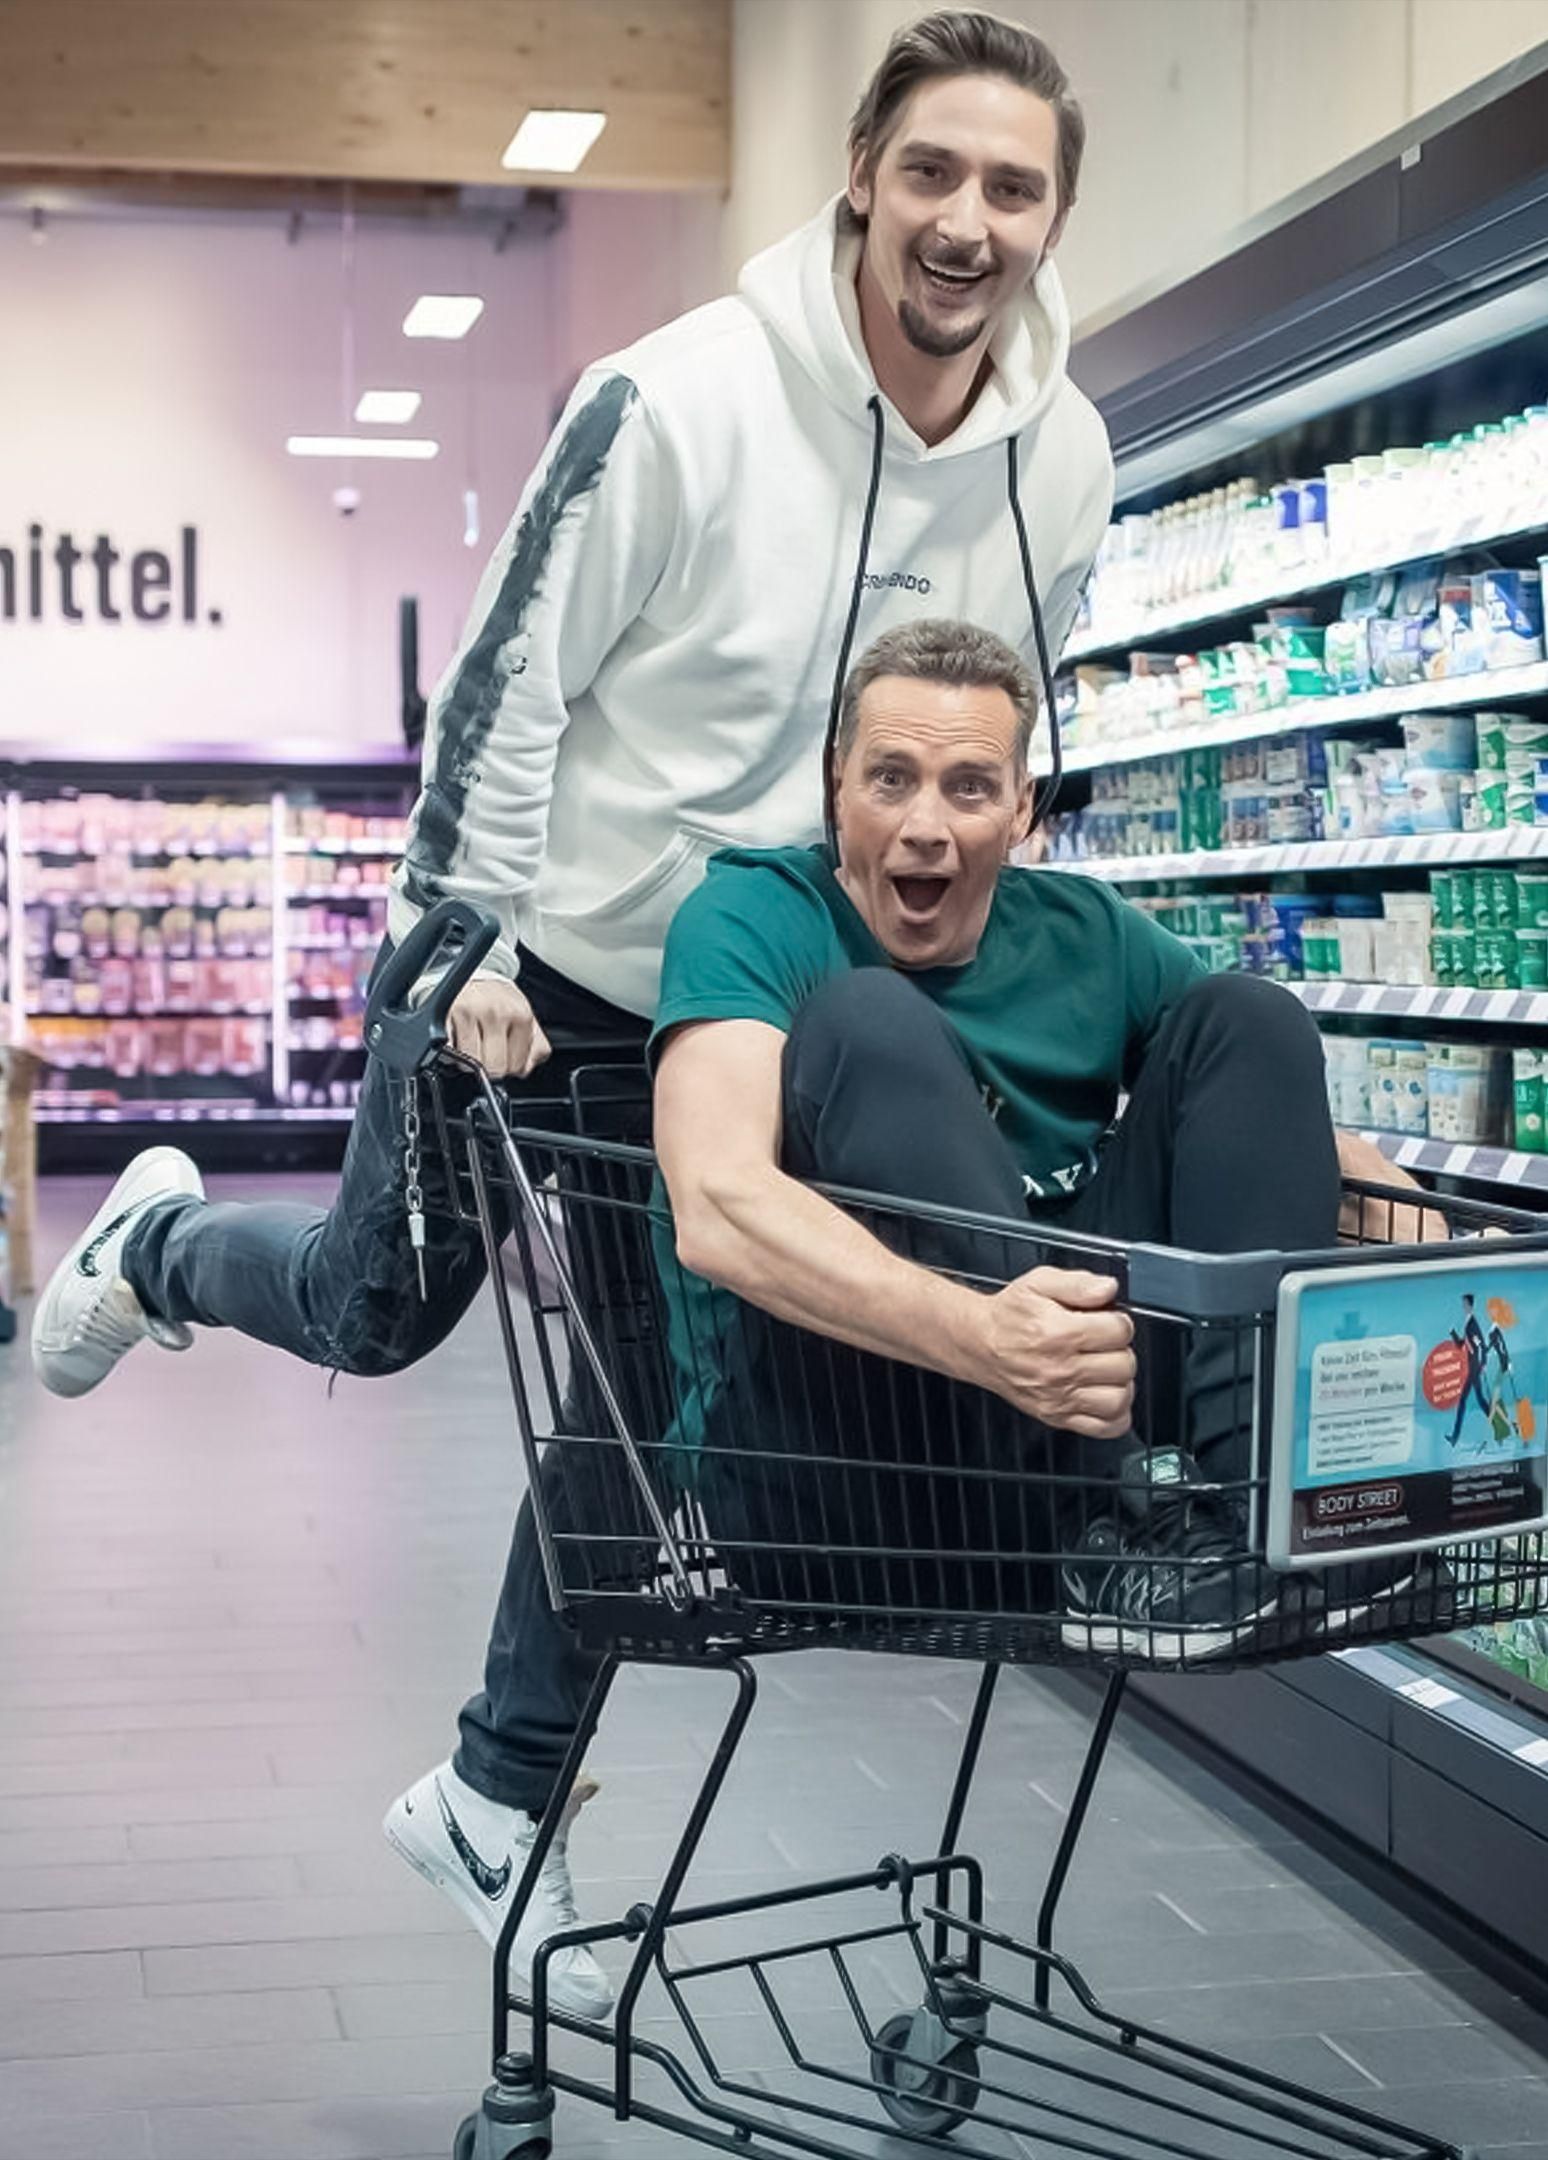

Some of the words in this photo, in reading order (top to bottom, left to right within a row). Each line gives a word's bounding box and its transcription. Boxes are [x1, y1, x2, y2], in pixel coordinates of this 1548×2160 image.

[0, 522, 222, 622] ittel.
[1318, 1494, 1355, 1515] BODY
[1356, 1488, 1398, 1509] STREET
